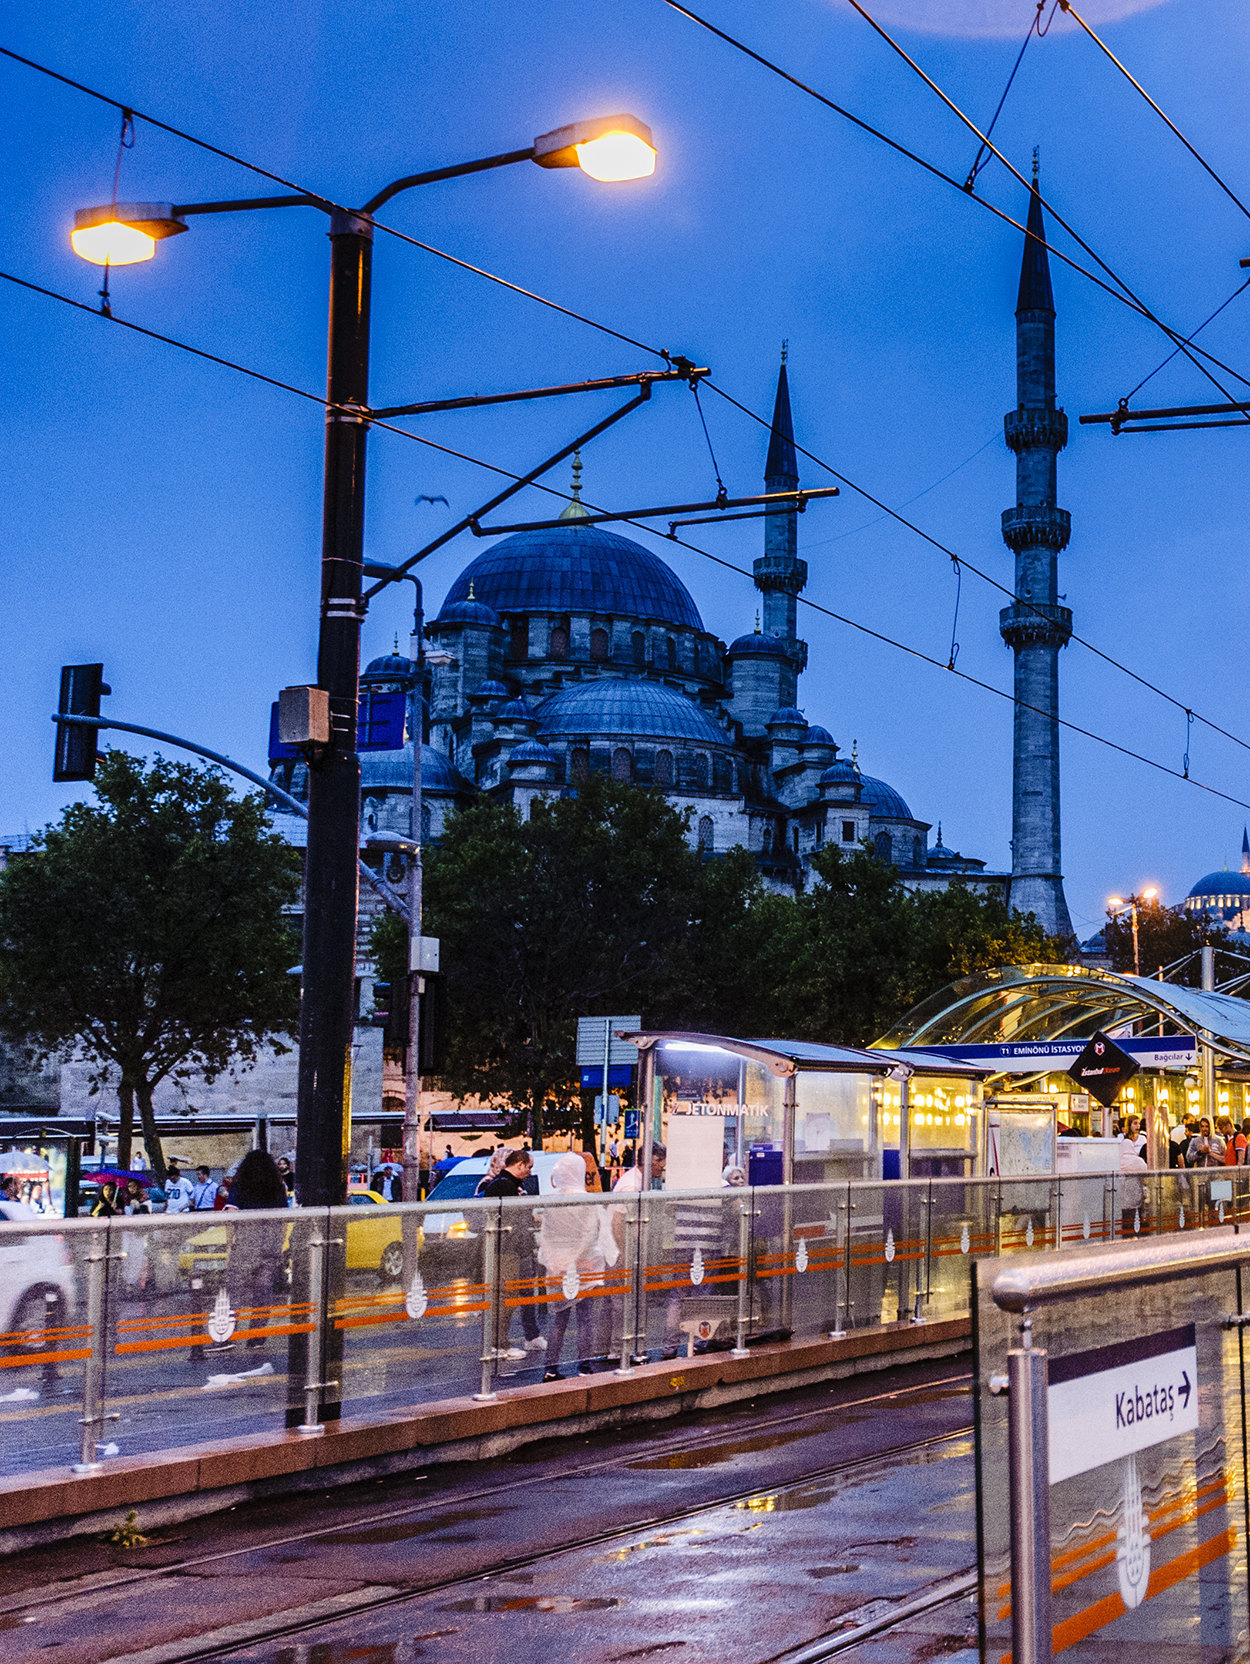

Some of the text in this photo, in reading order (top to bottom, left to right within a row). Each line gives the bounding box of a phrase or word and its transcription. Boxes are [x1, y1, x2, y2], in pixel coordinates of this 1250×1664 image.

[1013, 1045, 1050, 1055] EMİNÖNÜ
[1051, 1045, 1087, 1054] İSTASYON
[1154, 1053, 1184, 1063] Bağcılar
[685, 1102, 769, 1117] JETONMATİK
[1115, 1384, 1175, 1429] Kabataş
